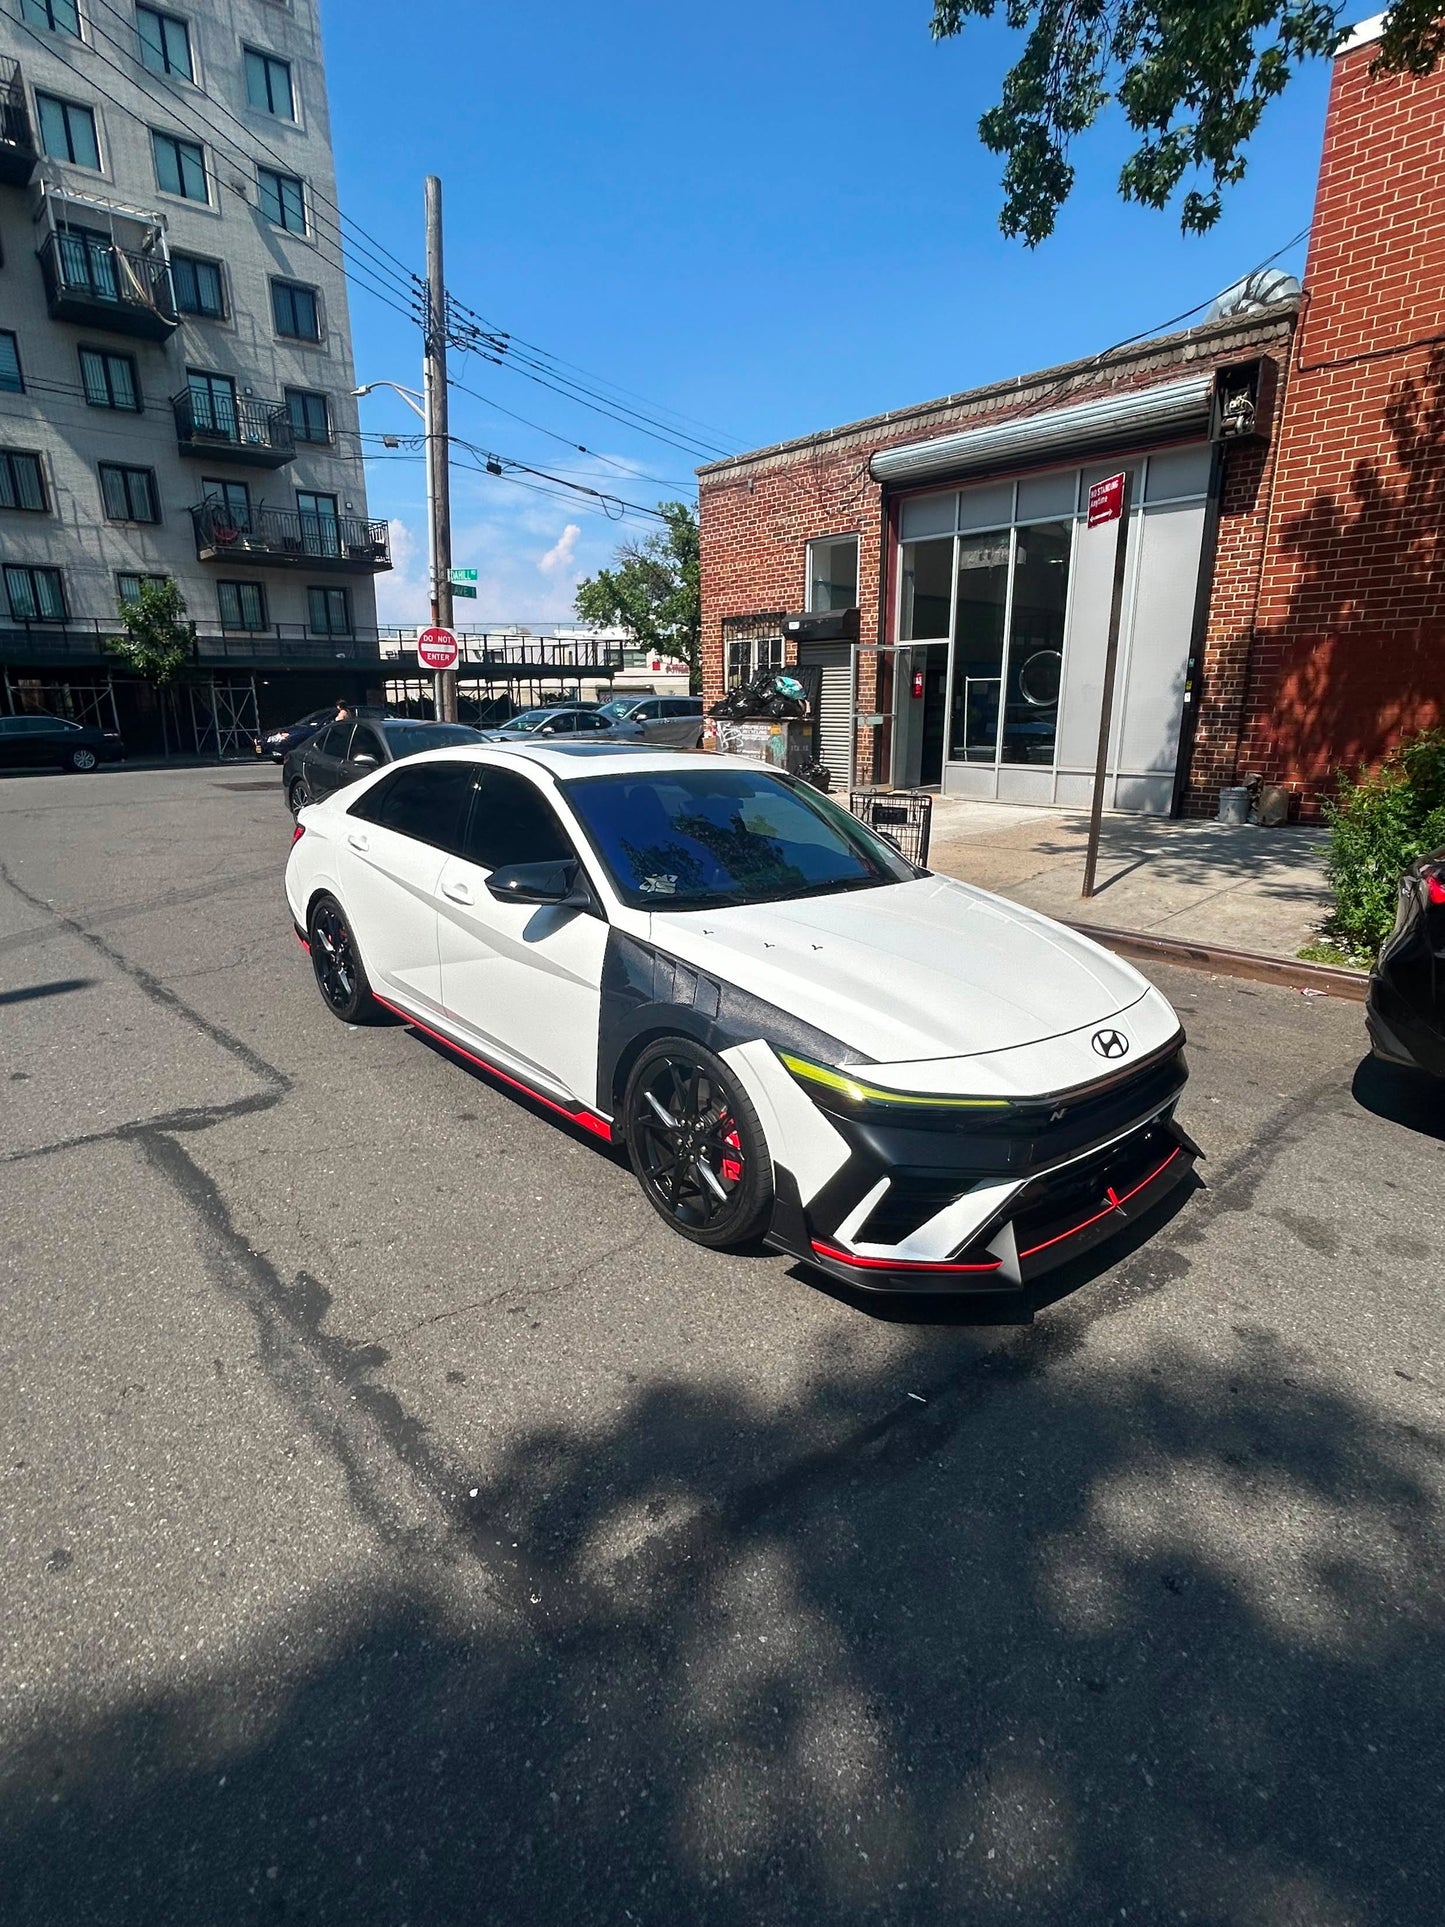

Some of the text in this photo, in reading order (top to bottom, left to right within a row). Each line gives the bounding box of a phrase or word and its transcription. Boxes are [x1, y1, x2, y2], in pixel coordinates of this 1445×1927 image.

[1090, 479, 1119, 499] NO STANDING
[451, 569, 471, 580] DAHILL
[454, 585, 469, 597] AVE
[423, 634, 452, 644] DO NOT
[426, 653, 450, 661] ENTER
